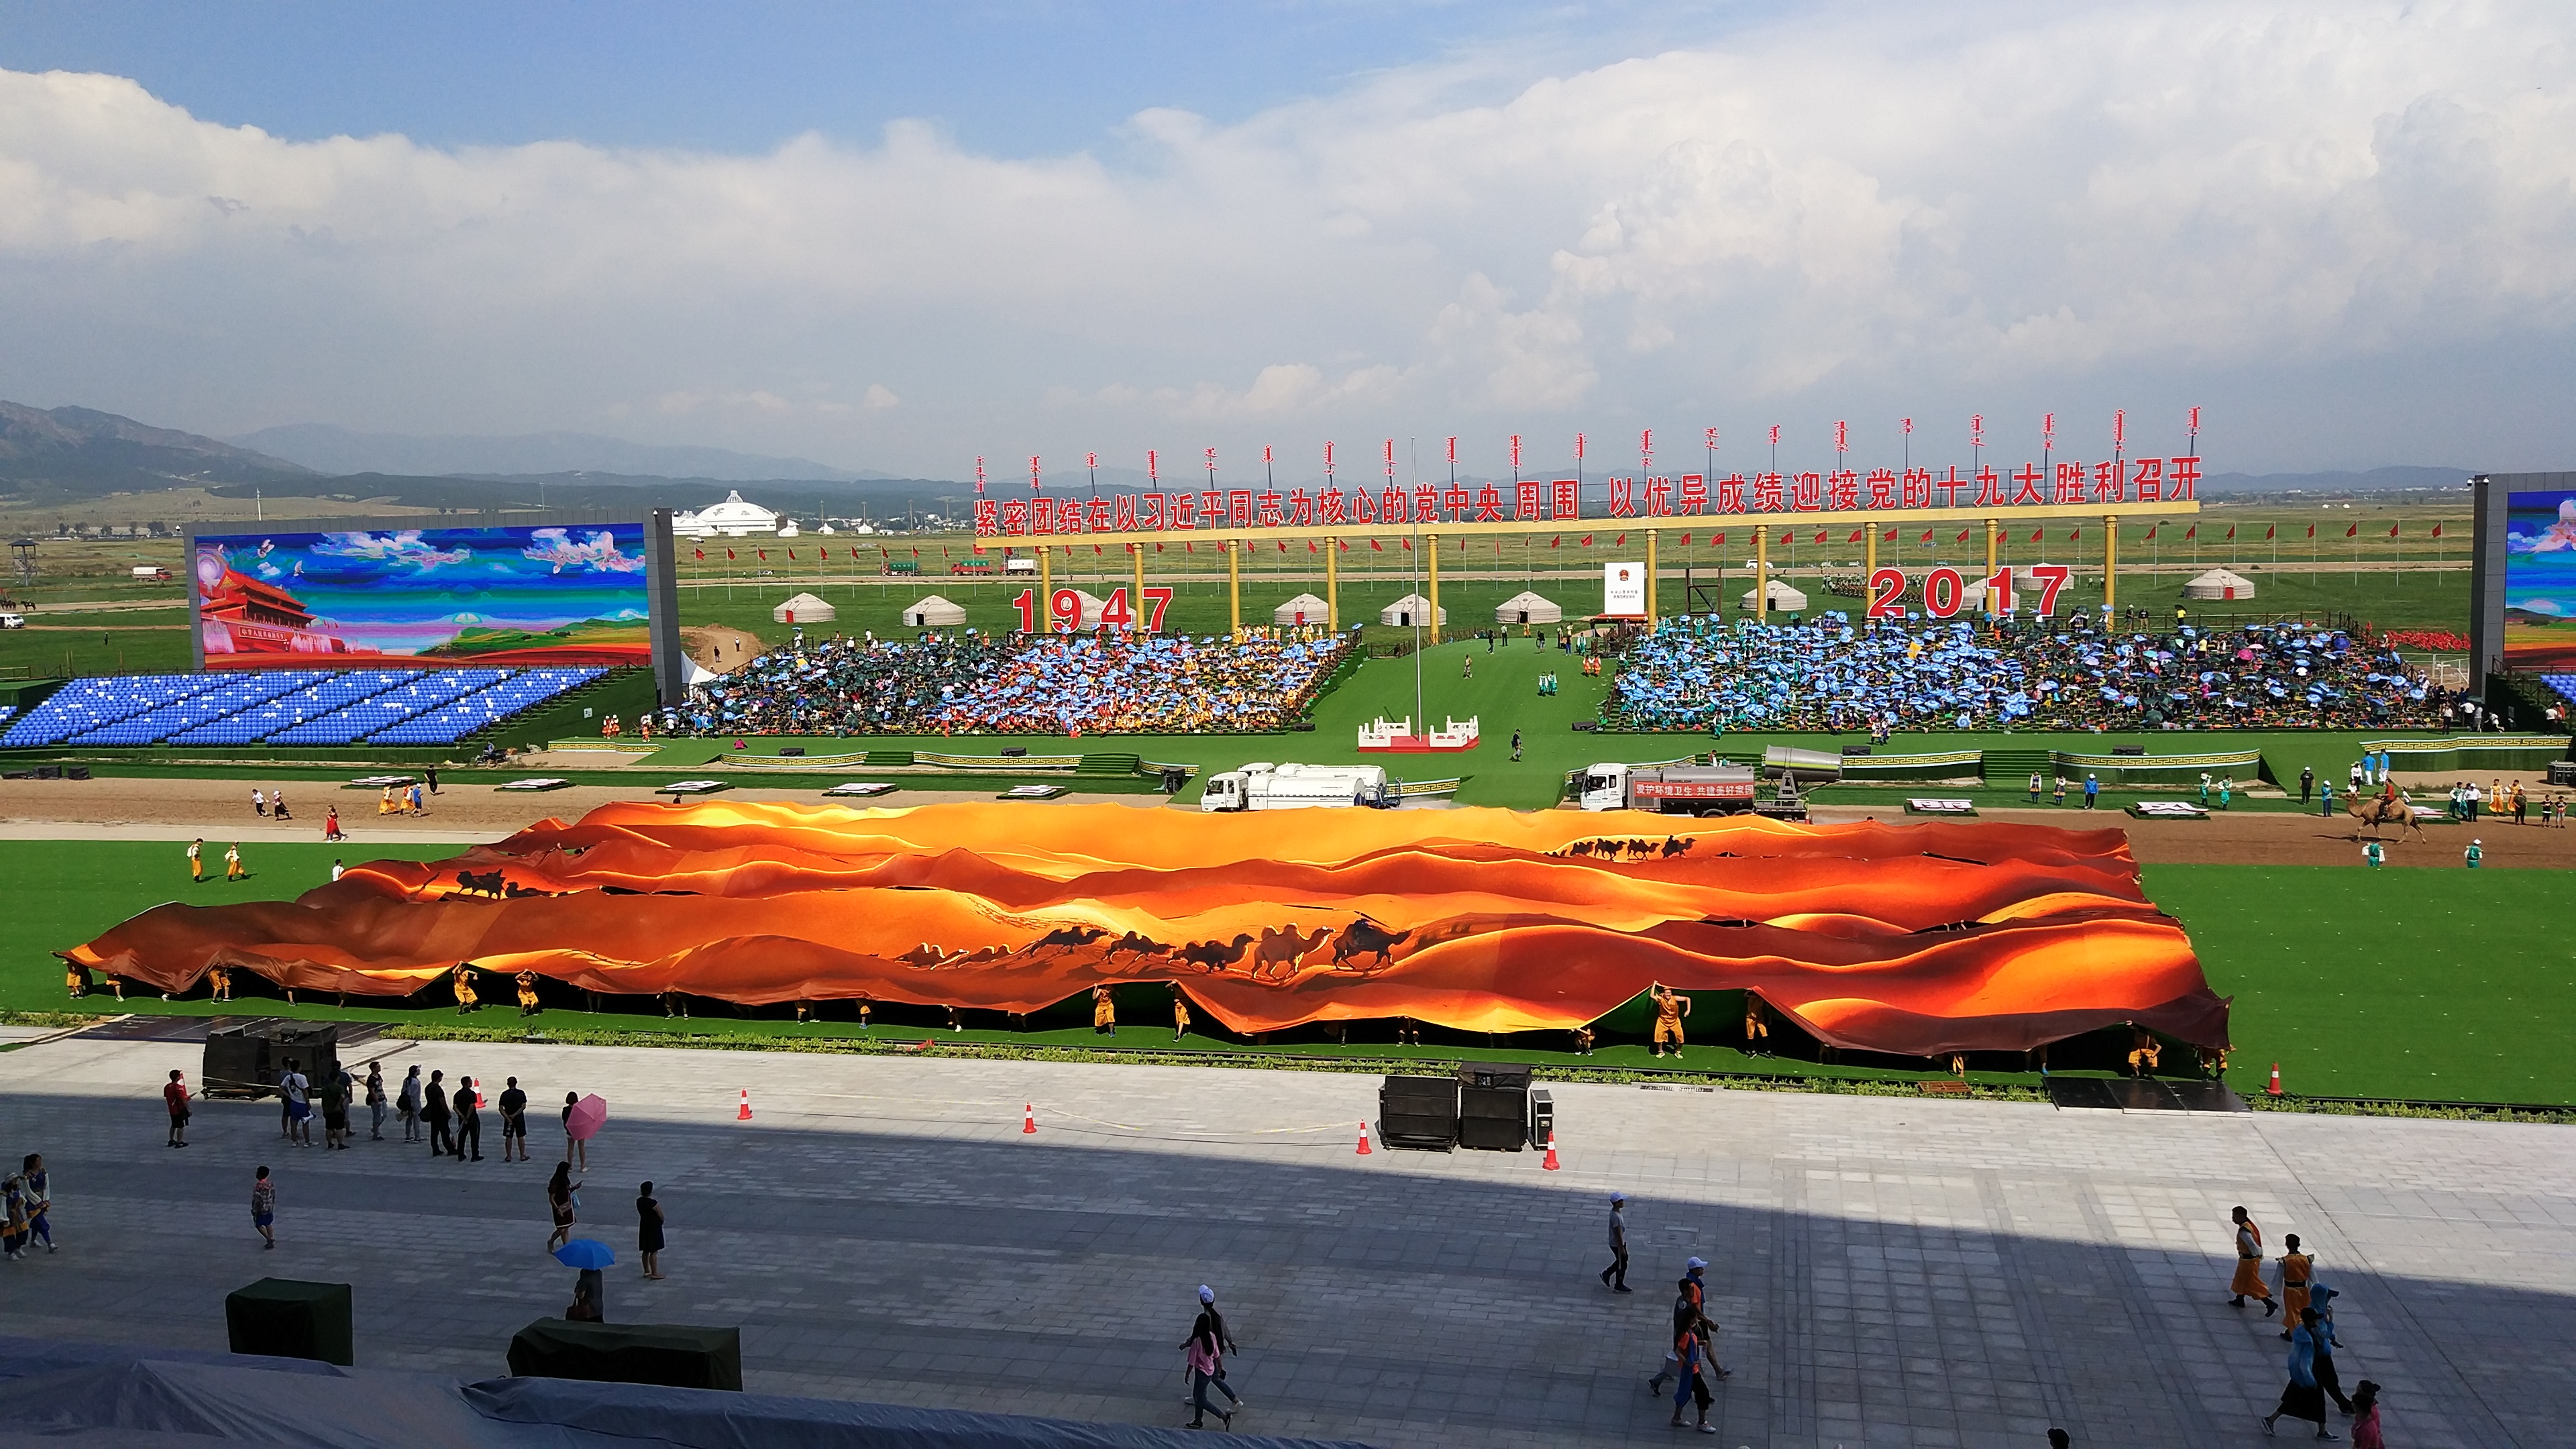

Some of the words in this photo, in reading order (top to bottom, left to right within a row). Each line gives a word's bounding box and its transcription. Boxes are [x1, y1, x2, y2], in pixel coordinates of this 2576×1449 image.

[974, 479, 1579, 537] 紧密团结在以习近平同志为核心的党中央周围
[1609, 455, 2202, 519] 以优异成绩迎接党的十九大胜利召开
[1013, 587, 1173, 634] 1947
[1866, 565, 2070, 619] 2017
[1635, 784, 1693, 796] 爱护环境卫生
[1697, 784, 1754, 796] 共建美好家园
